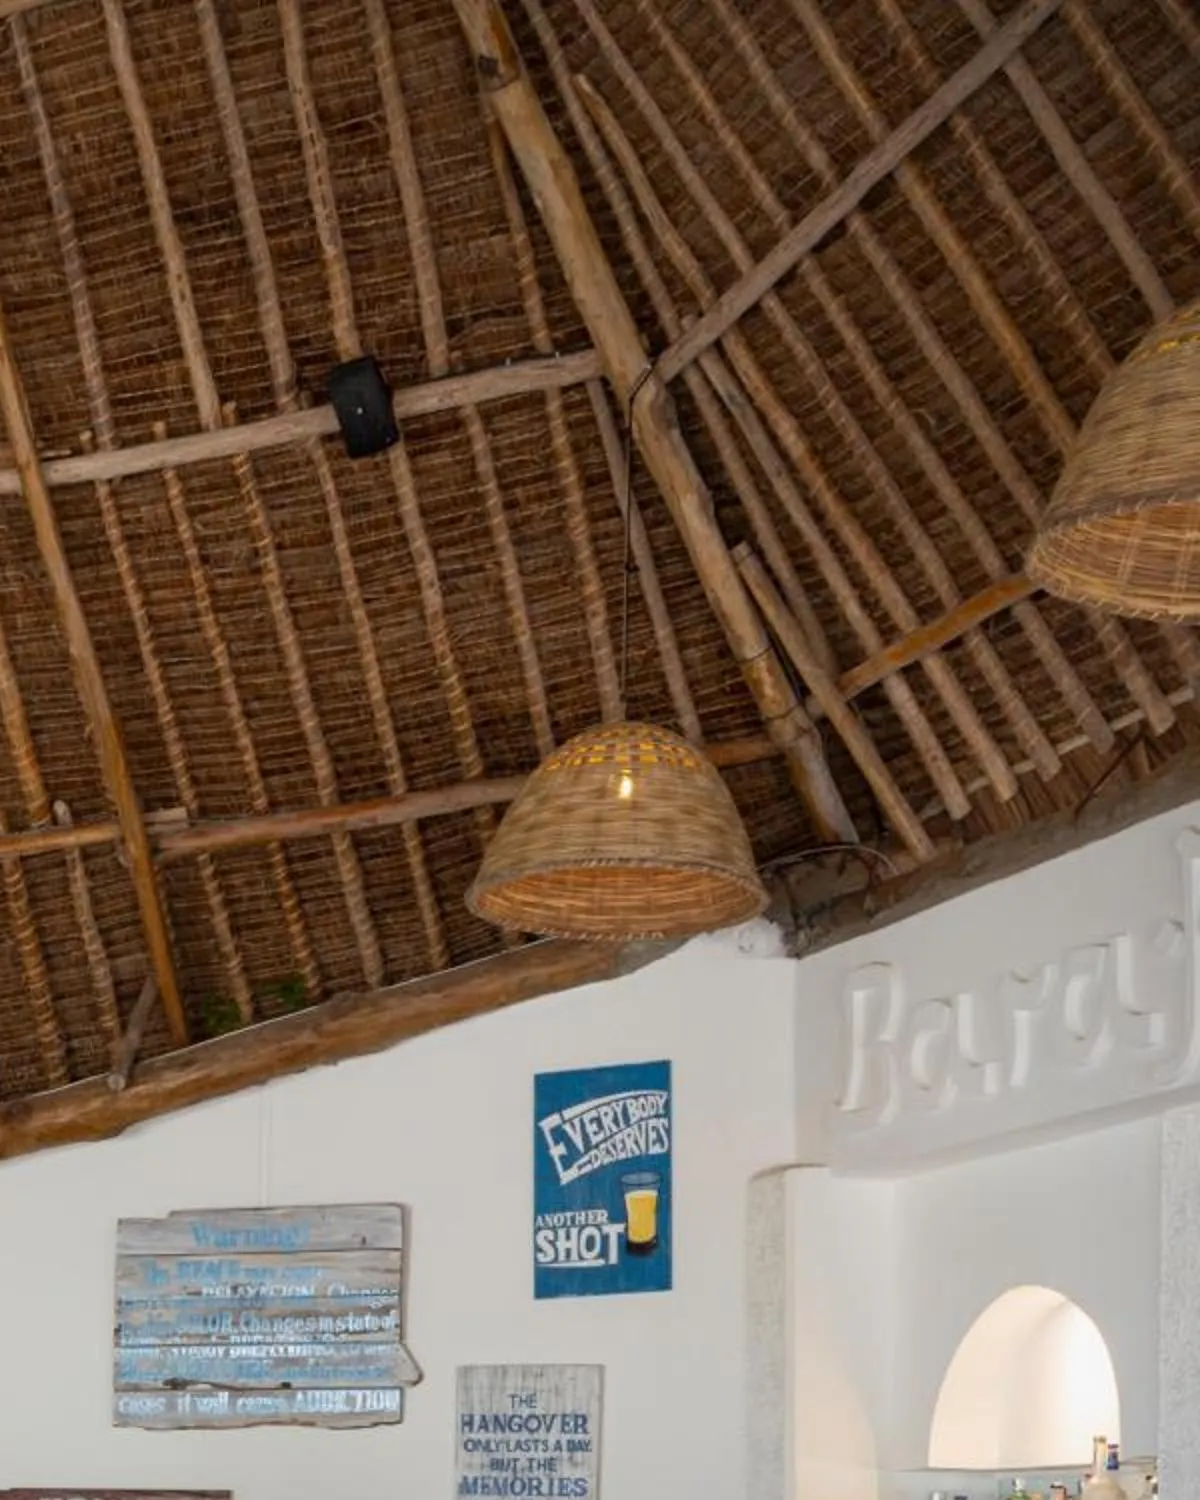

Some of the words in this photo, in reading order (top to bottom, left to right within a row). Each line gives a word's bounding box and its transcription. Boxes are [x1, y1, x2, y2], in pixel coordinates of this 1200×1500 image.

[538, 1089, 668, 1185] EVERYBODY
[589, 1118, 669, 1168] DESERVES
[535, 1209, 608, 1228] ANOTHER
[535, 1224, 626, 1265] SHOT
[507, 1393, 537, 1409] THE
[460, 1413, 590, 1435] HANGOVER
[463, 1438, 504, 1453] ONLY
[506, 1438, 551, 1453] LASTS
[553, 1439, 564, 1453] A
[489, 1457, 518, 1475] BUT
[526, 1457, 558, 1473] THE
[458, 1475, 589, 1498] MEMORIES
